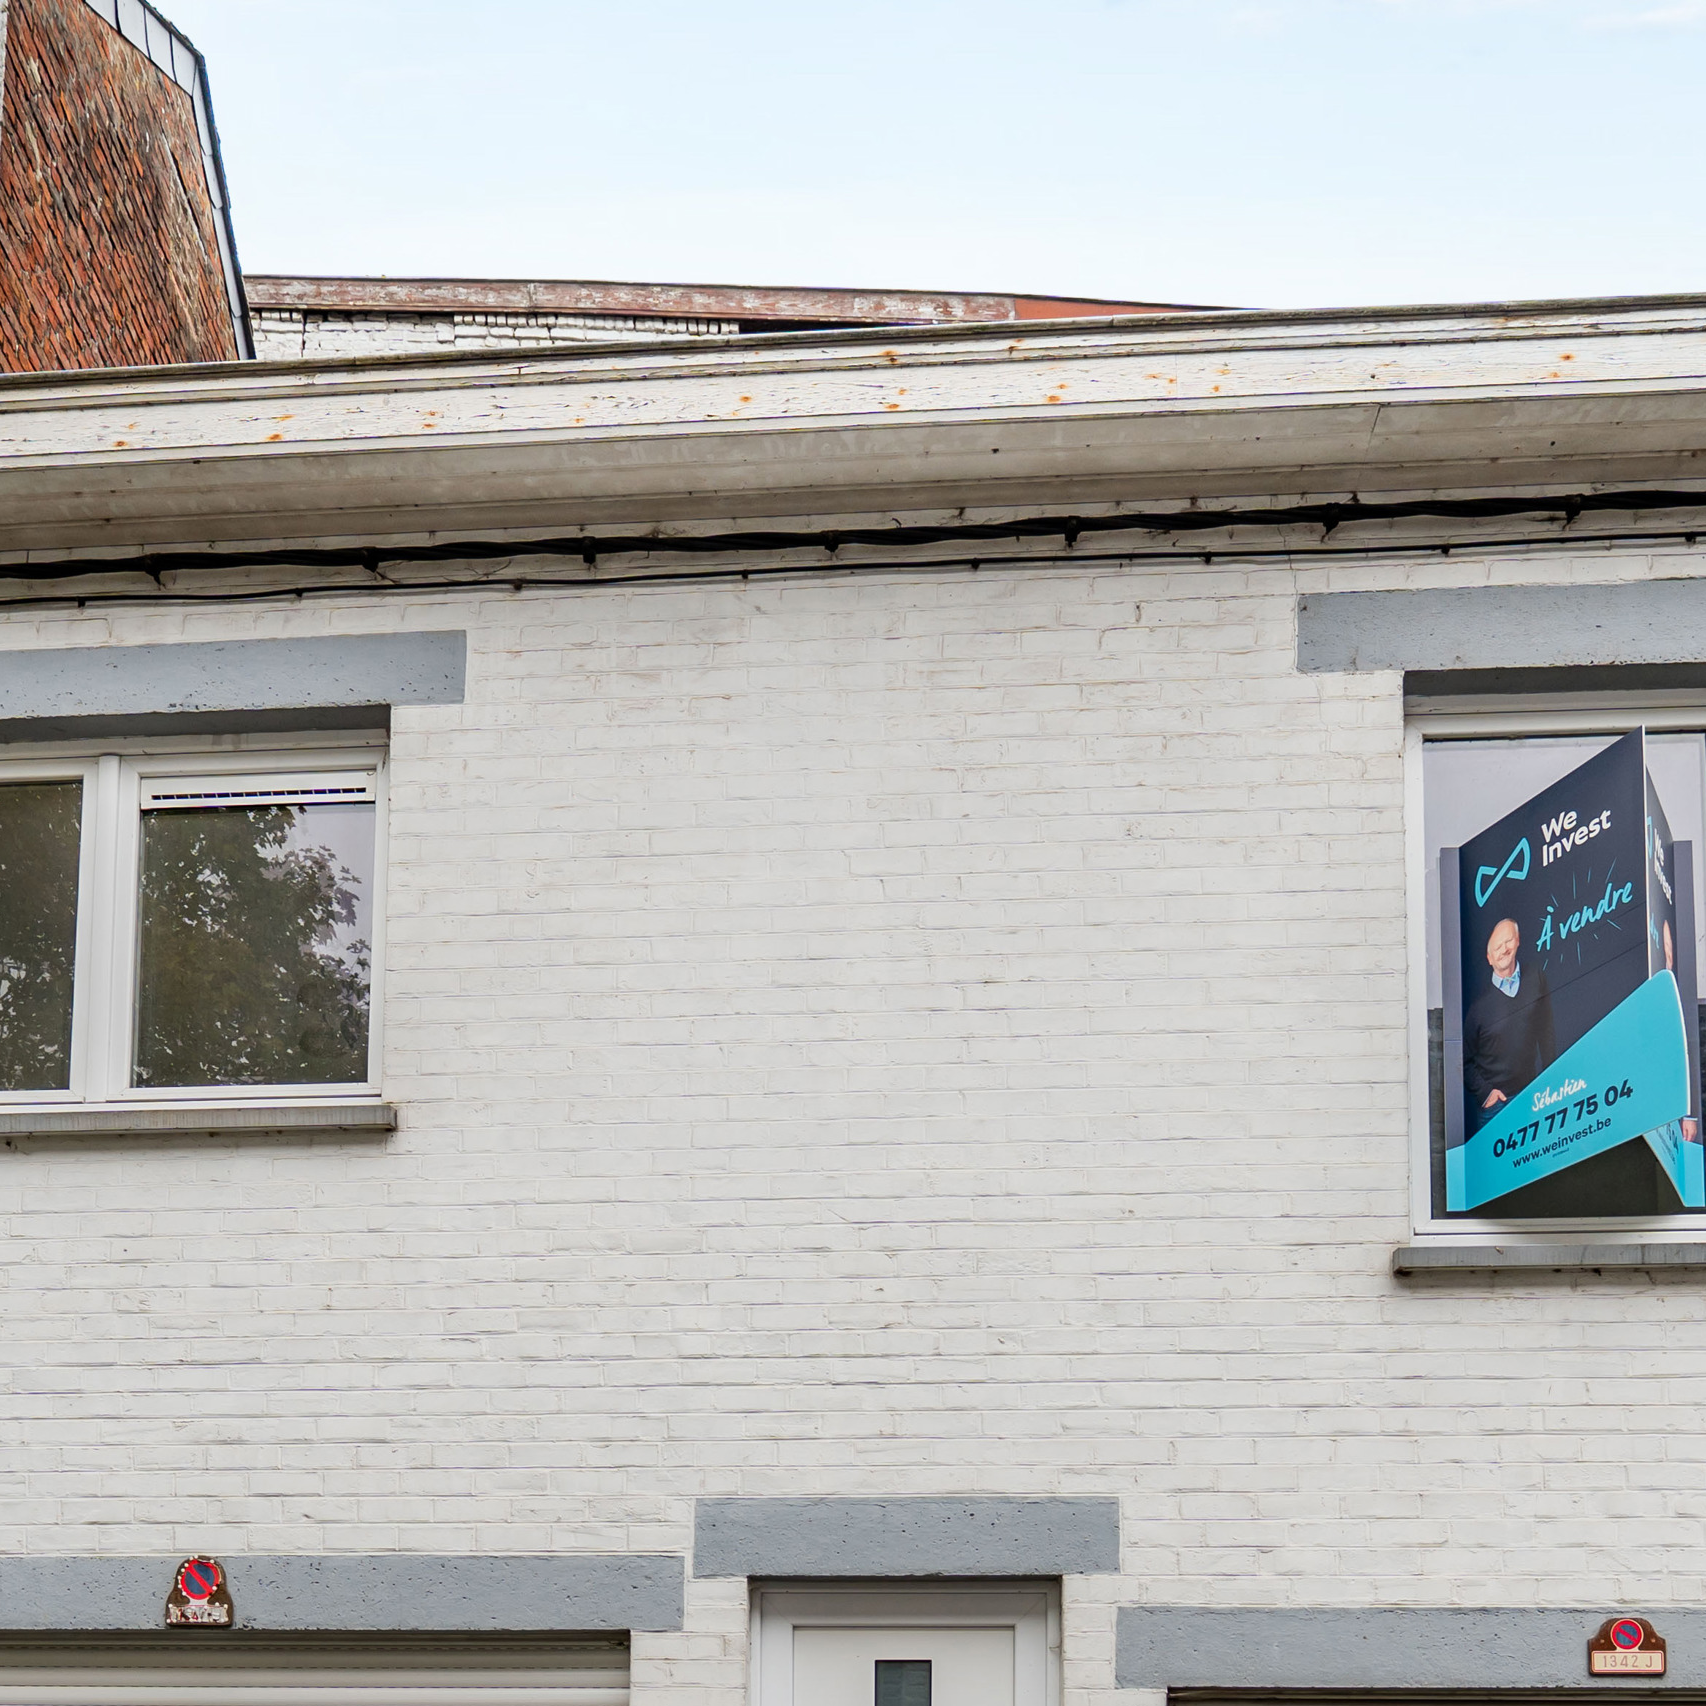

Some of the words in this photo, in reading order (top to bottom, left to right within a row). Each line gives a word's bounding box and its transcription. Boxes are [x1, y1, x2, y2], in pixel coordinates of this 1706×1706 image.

[1541, 810, 1577, 843] We
[1542, 809, 1612, 867] Invest
[1536, 905, 1554, 952] À
[1559, 881, 1633, 940] vendre
[1493, 1120, 1540, 1158] 0477
[1544, 1107, 1568, 1135] 77
[1573, 1093, 1599, 1121] 75
[1604, 1079, 1633, 1107] 04
[1531, 1078, 1587, 1112] Sébastien
[1512, 1117, 1612, 1168] www.weinvest.be
[1603, 1655, 1639, 1668] 1342
[1645, 1655, 1653, 1668] J
